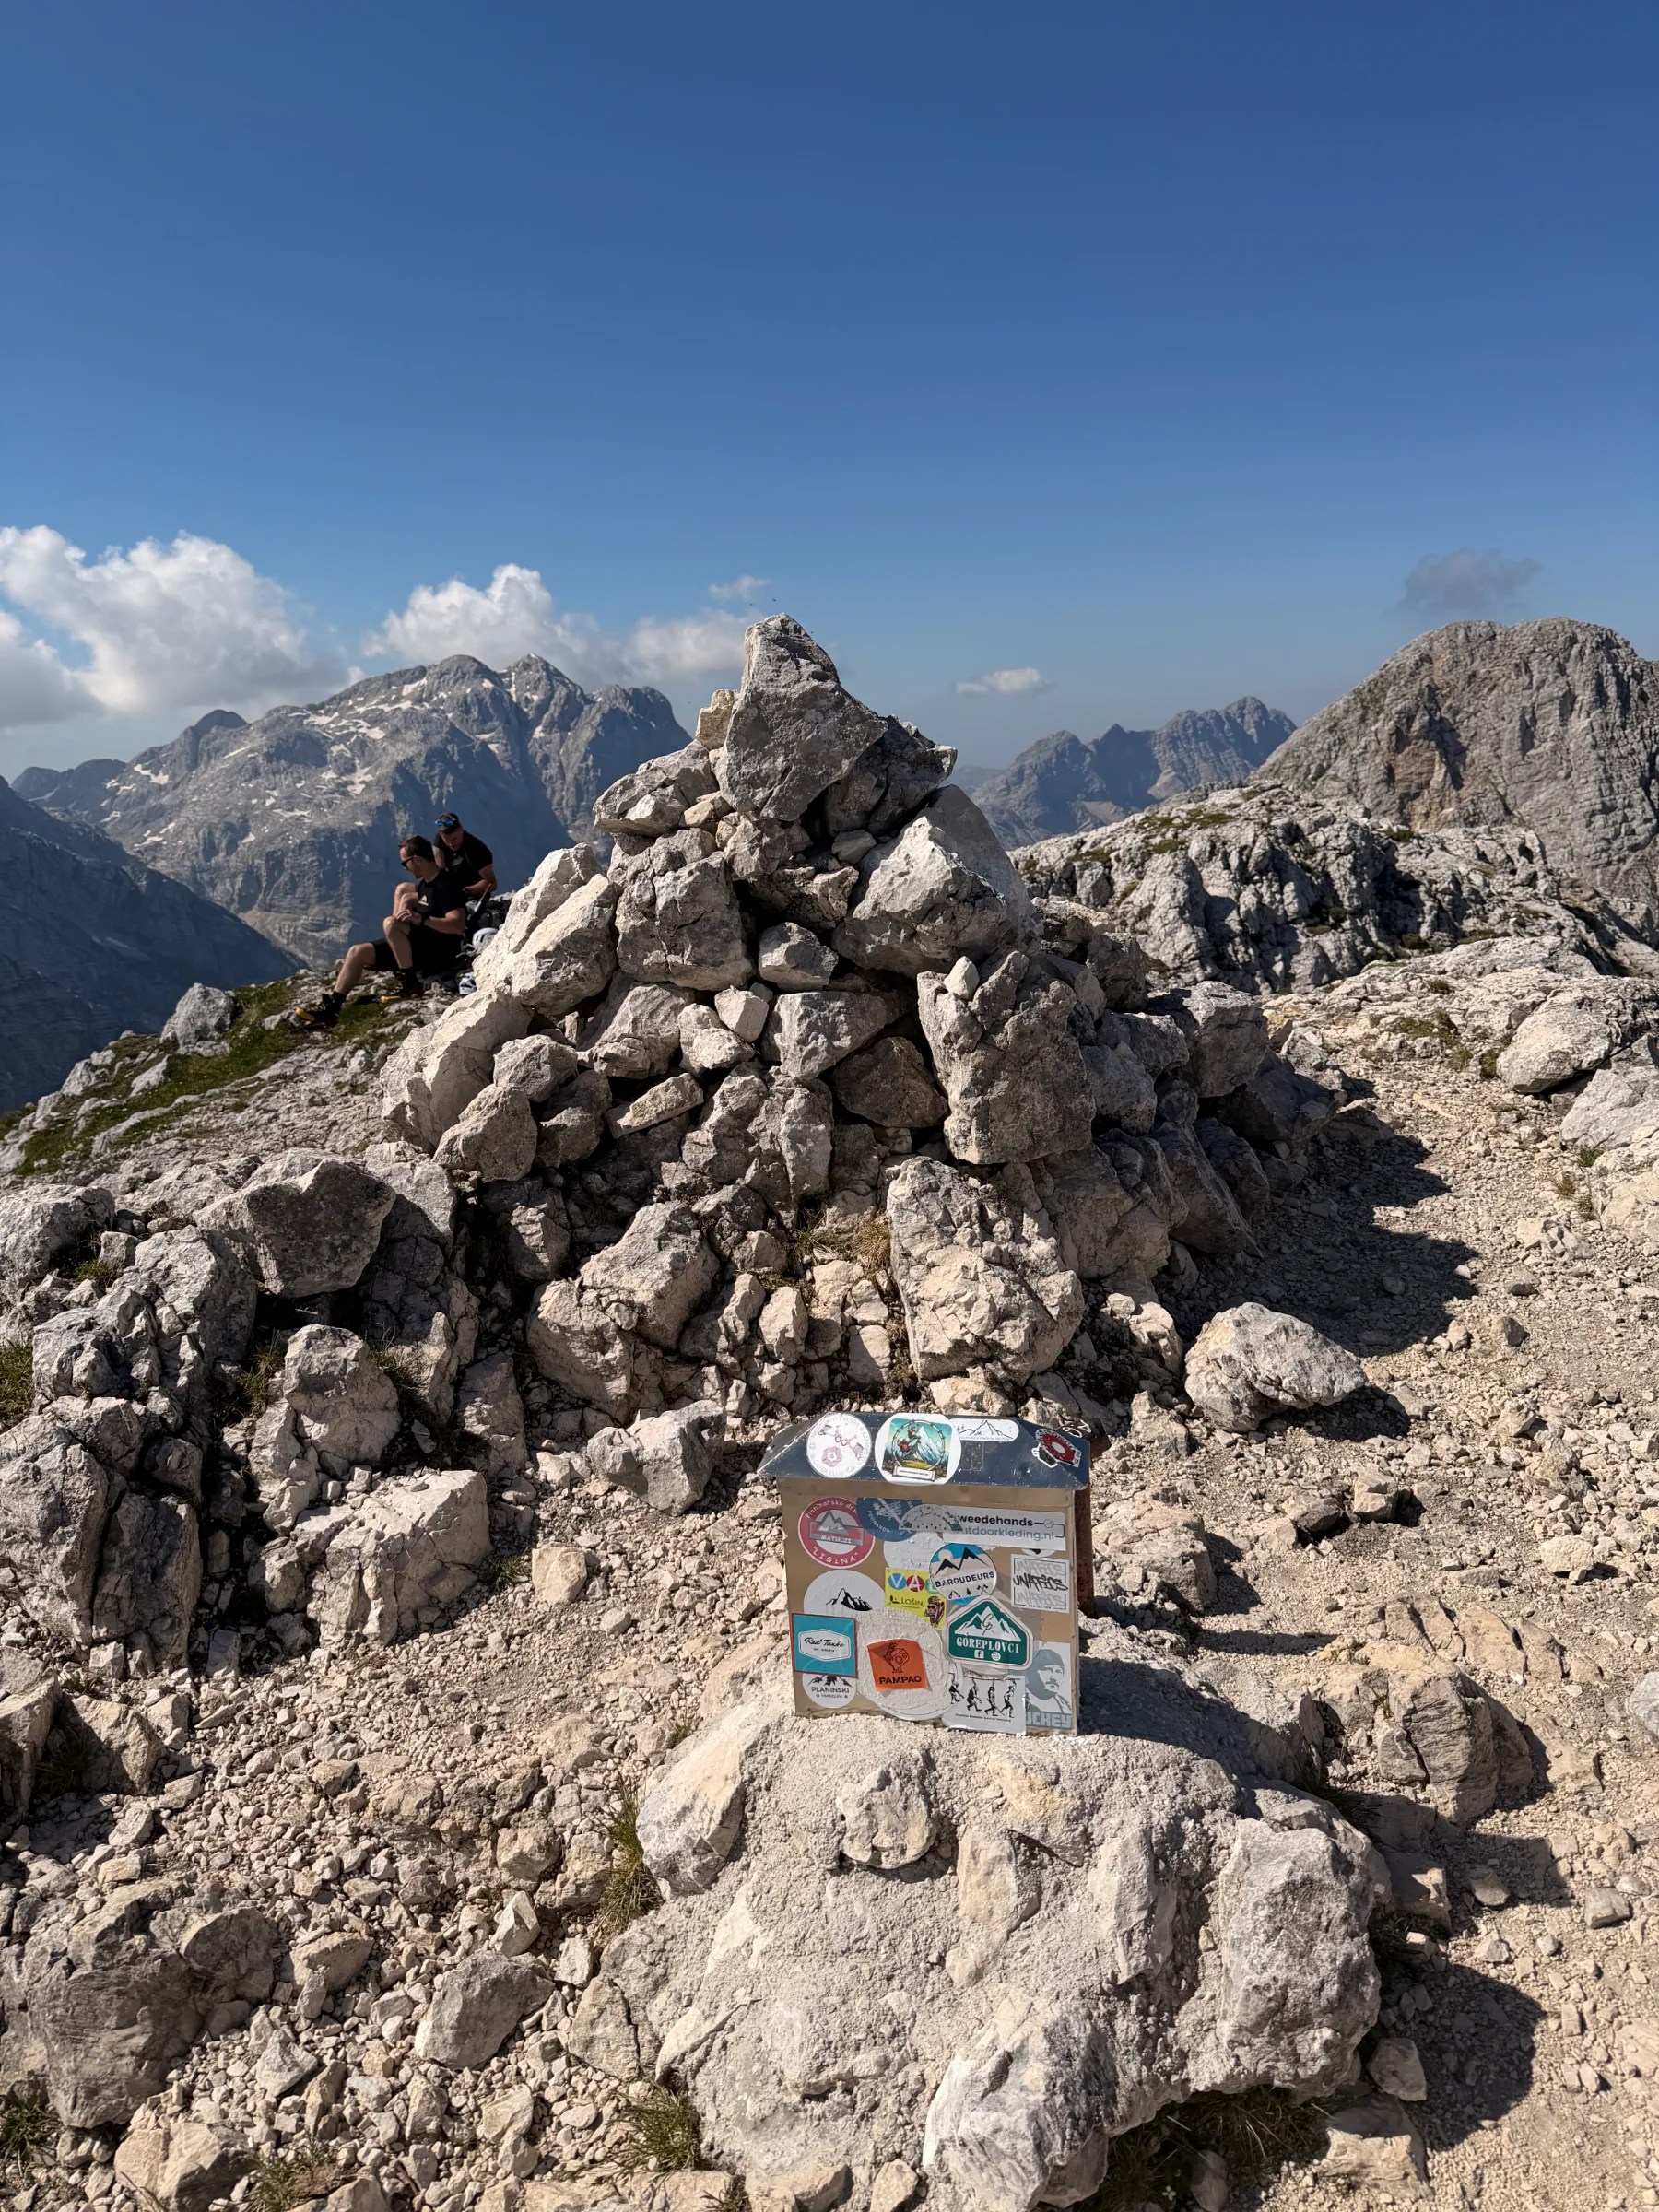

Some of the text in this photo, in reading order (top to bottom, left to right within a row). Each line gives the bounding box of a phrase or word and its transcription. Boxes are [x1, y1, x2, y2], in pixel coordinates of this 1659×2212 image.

[805, 1500, 859, 1519] Planinarsko dru
[958, 1515, 1033, 1527] weedehands
[965, 1526, 1054, 1542] tdoorkleding.nl
[935, 1571, 995, 1588] BAROUDEURS
[900, 1596, 925, 1607] LOŠINJ
[956, 1636, 1020, 1654] GOREPLOVCI
[878, 1675, 922, 1685] PAMPAO
[811, 1686, 850, 1694] PLANINSKI
